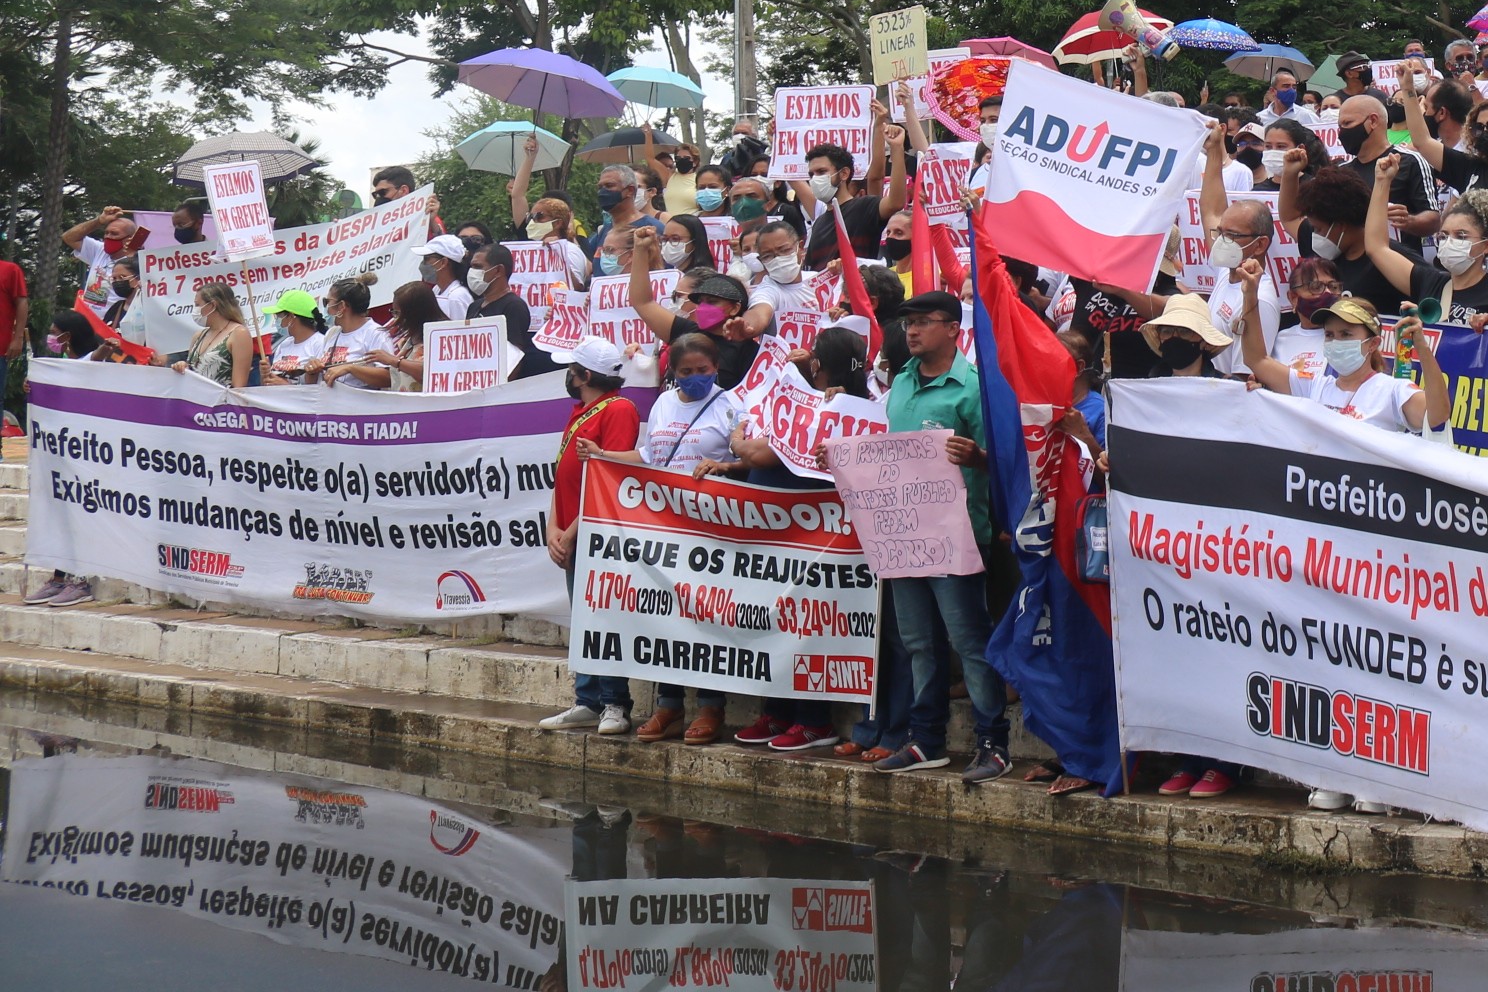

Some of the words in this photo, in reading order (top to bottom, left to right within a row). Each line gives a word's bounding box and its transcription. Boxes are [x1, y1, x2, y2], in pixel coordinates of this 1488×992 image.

[880, 33, 916, 55] LINEAR
[785, 93, 861, 121] ESTAMOS
[778, 131, 799, 155] EM
[1003, 105, 1178, 184] ADUFPI
[1000, 139, 1038, 164] SEÇÃO
[1039, 157, 1094, 183] SINDICAL
[1096, 175, 1140, 194] ANDES
[213, 170, 255, 198] ESTAMOS
[217, 209, 233, 233] EM
[230, 202, 267, 229] GREVE!
[294, 232, 318, 253] da
[326, 212, 378, 245] UESPI
[381, 194, 424, 226] estão
[147, 279, 168, 298] há
[175, 275, 186, 294] 7
[240, 265, 268, 284] sem
[272, 249, 345, 279] reajuste
[348, 224, 409, 259] salarial
[359, 253, 395, 274] UESPI
[438, 332, 493, 361] ESTAMOS
[791, 390, 822, 407] SINTE-PI
[194, 412, 248, 430] CHEGA
[253, 416, 273, 433] DE
[277, 418, 360, 439] CONVERSA
[364, 421, 418, 439] FIADA!
[772, 439, 782, 450] DA
[833, 442, 850, 467] OS
[31, 420, 113, 465] Prefeito
[121, 437, 214, 486] Pessoa,
[220, 455, 318, 492] respeite
[325, 461, 369, 503] o(a)
[375, 457, 510, 499] servidor(a)
[879, 464, 900, 484] DO
[617, 475, 853, 536] GOVERNADOR!
[902, 476, 957, 505] PÚBLICO
[1286, 464, 1406, 524] Prefeito
[1415, 487, 1488, 536] José
[158, 496, 282, 541] mudanças
[289, 509, 319, 542] de
[325, 511, 384, 548] nível
[389, 523, 405, 549] e
[410, 512, 502, 549] revisão
[873, 509, 919, 535] PEDEM
[158, 544, 230, 577] SINDSERM
[589, 533, 680, 569] PAGUE
[688, 546, 725, 575] OS
[1129, 510, 1293, 583] Magistério
[1305, 537, 1460, 621] Municipal
[443, 593, 471, 605] Travessia
[1143, 587, 1165, 631] O
[1173, 599, 1252, 648] rateio
[1261, 611, 1298, 657] do
[1302, 617, 1428, 685] FUNDEB
[1437, 643, 1454, 690] é
[582, 630, 622, 661] NA
[633, 635, 772, 682] CARREIRA
[1248, 673, 1430, 775] SINDSERM
